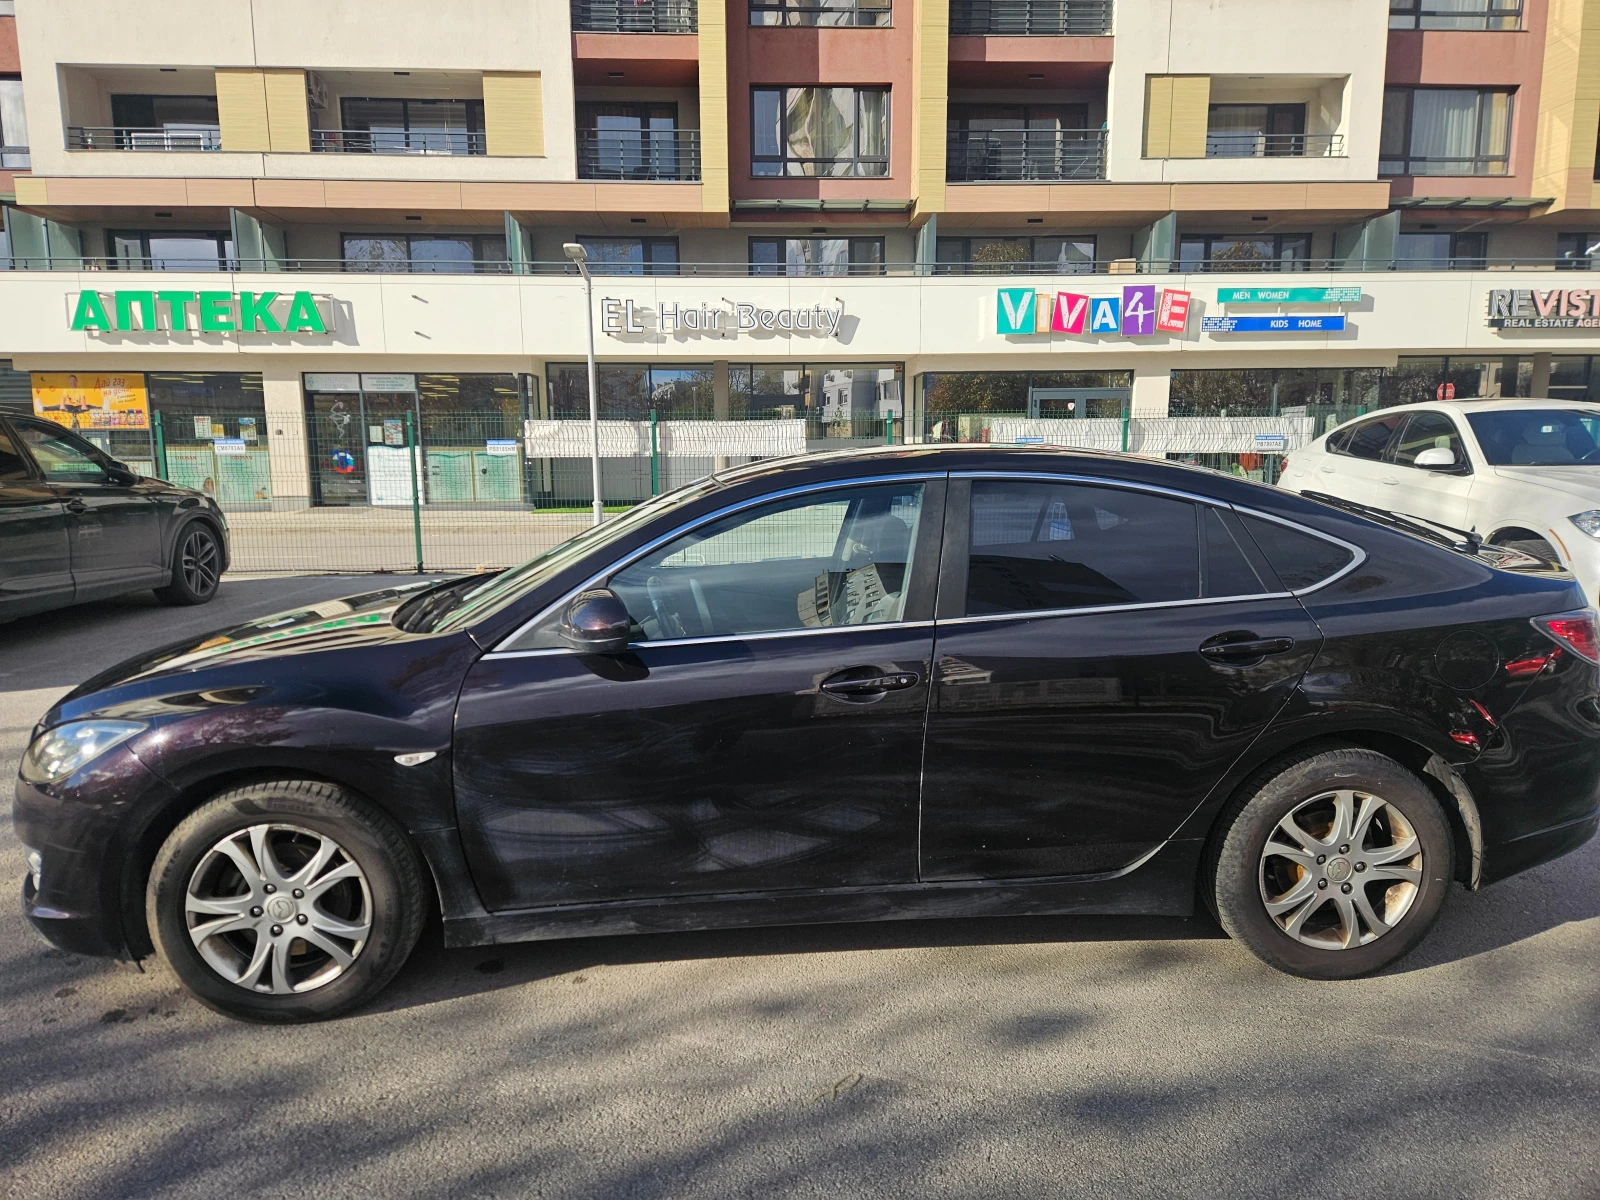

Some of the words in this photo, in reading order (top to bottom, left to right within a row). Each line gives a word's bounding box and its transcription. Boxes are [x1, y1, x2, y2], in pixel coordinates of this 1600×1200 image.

[1232, 291, 1251, 300] MEN
[1257, 291, 1290, 300] WOMEN
[70, 289, 326, 333] АПТЕКА
[601, 298, 645, 334] EL
[659, 301, 722, 332] Hair
[735, 302, 842, 336] Beauty
[997, 287, 1191, 335] VIVA4E
[1504, 318, 1533, 328] REAL
[1534, 318, 1574, 328] ESTATE
[1576, 318, 1600, 328] AGE
[1270, 319, 1289, 328] KIDS
[1297, 319, 1323, 328] HOME
